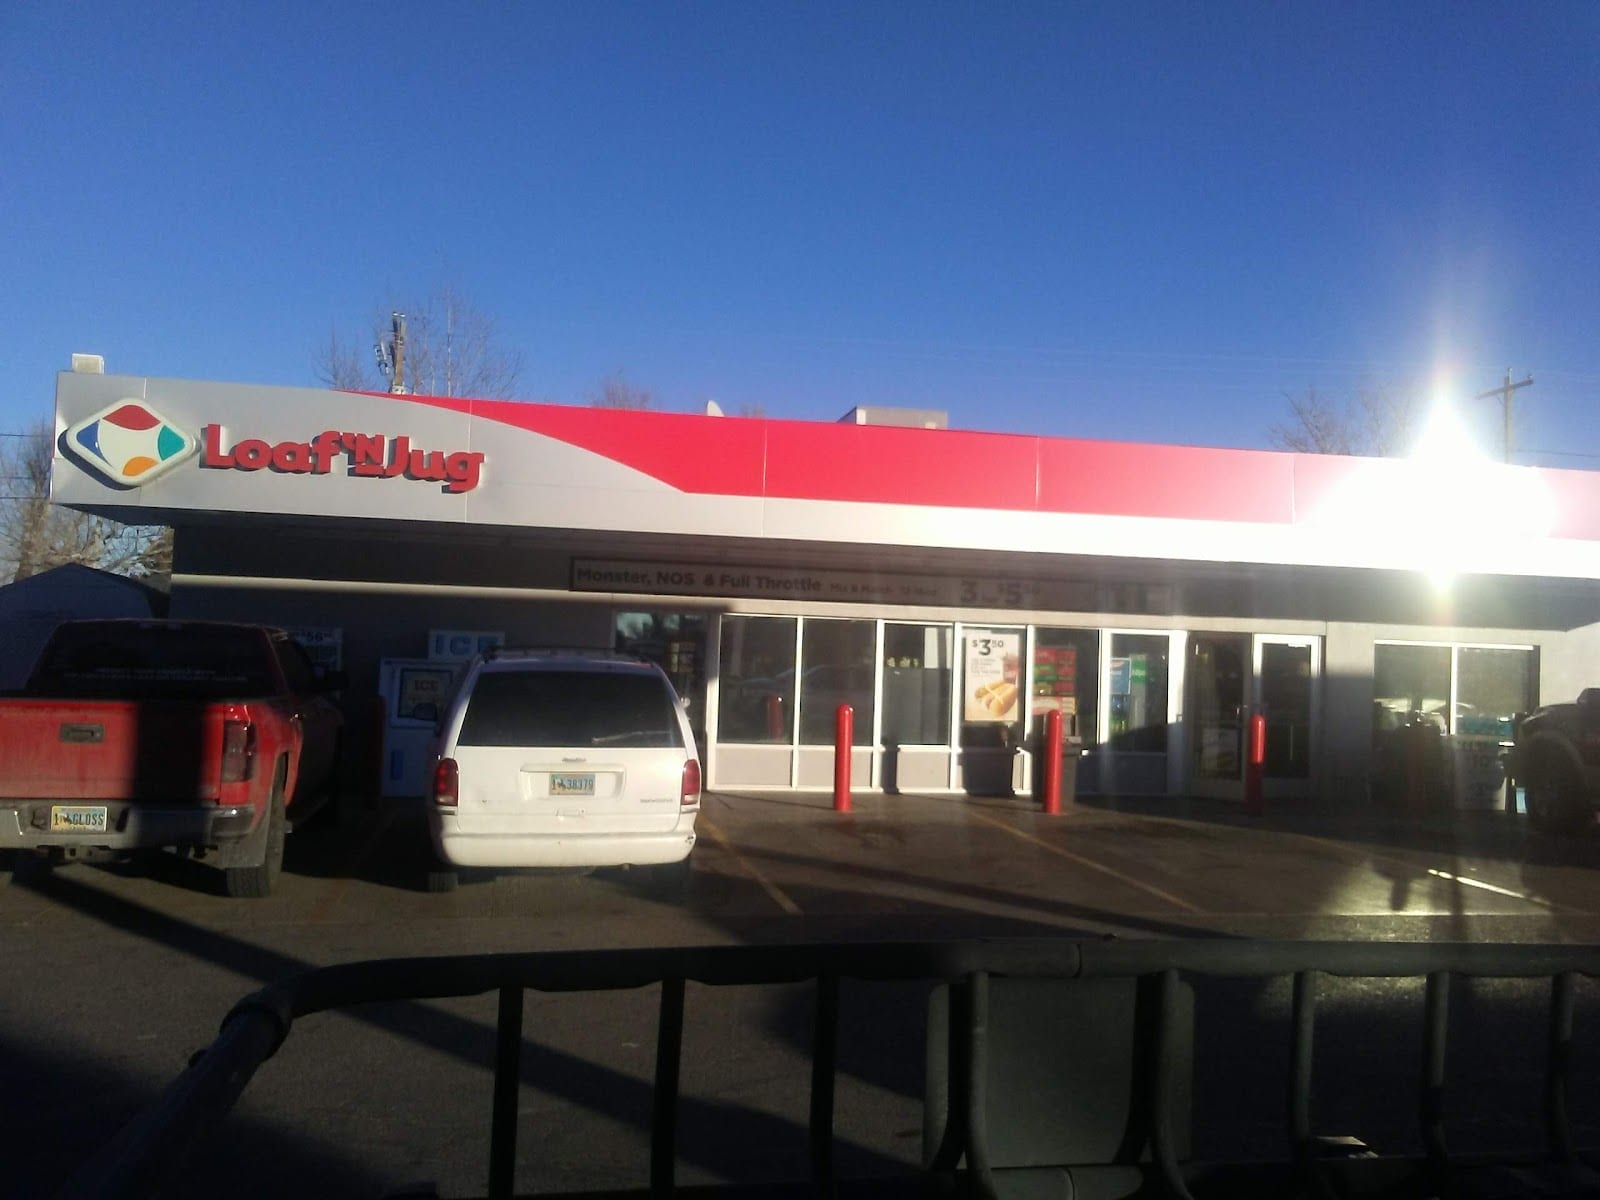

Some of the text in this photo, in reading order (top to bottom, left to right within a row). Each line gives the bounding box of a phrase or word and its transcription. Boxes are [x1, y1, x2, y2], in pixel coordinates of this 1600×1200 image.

[204, 423, 341, 474] Loaf
[384, 436, 485, 493] Jug
[577, 568, 651, 586] Monster,
[656, 570, 695, 585] NOS
[719, 574, 750, 588] Full
[755, 576, 821, 592] Throttle
